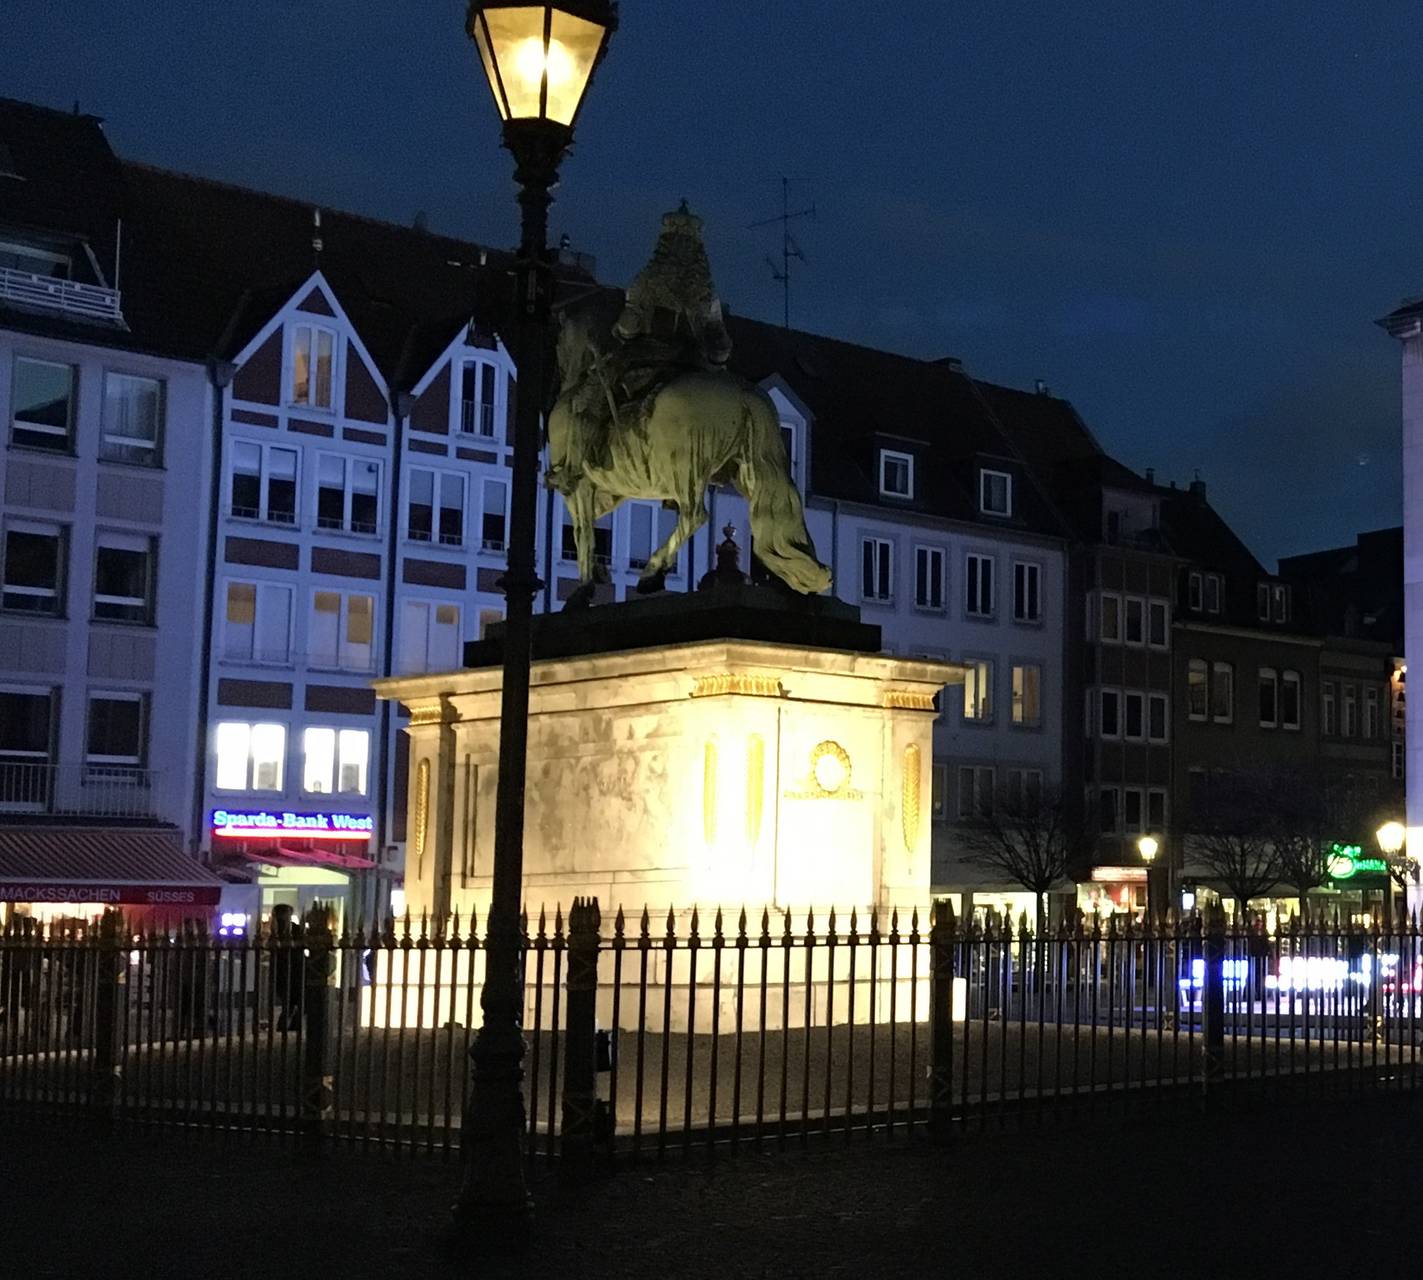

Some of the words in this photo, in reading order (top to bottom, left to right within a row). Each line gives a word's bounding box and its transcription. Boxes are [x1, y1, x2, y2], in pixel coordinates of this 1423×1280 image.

[213, 811, 329, 831] Sparda-Bank
[331, 814, 373, 830] West
[147, 890, 195, 903] SÜSSES
